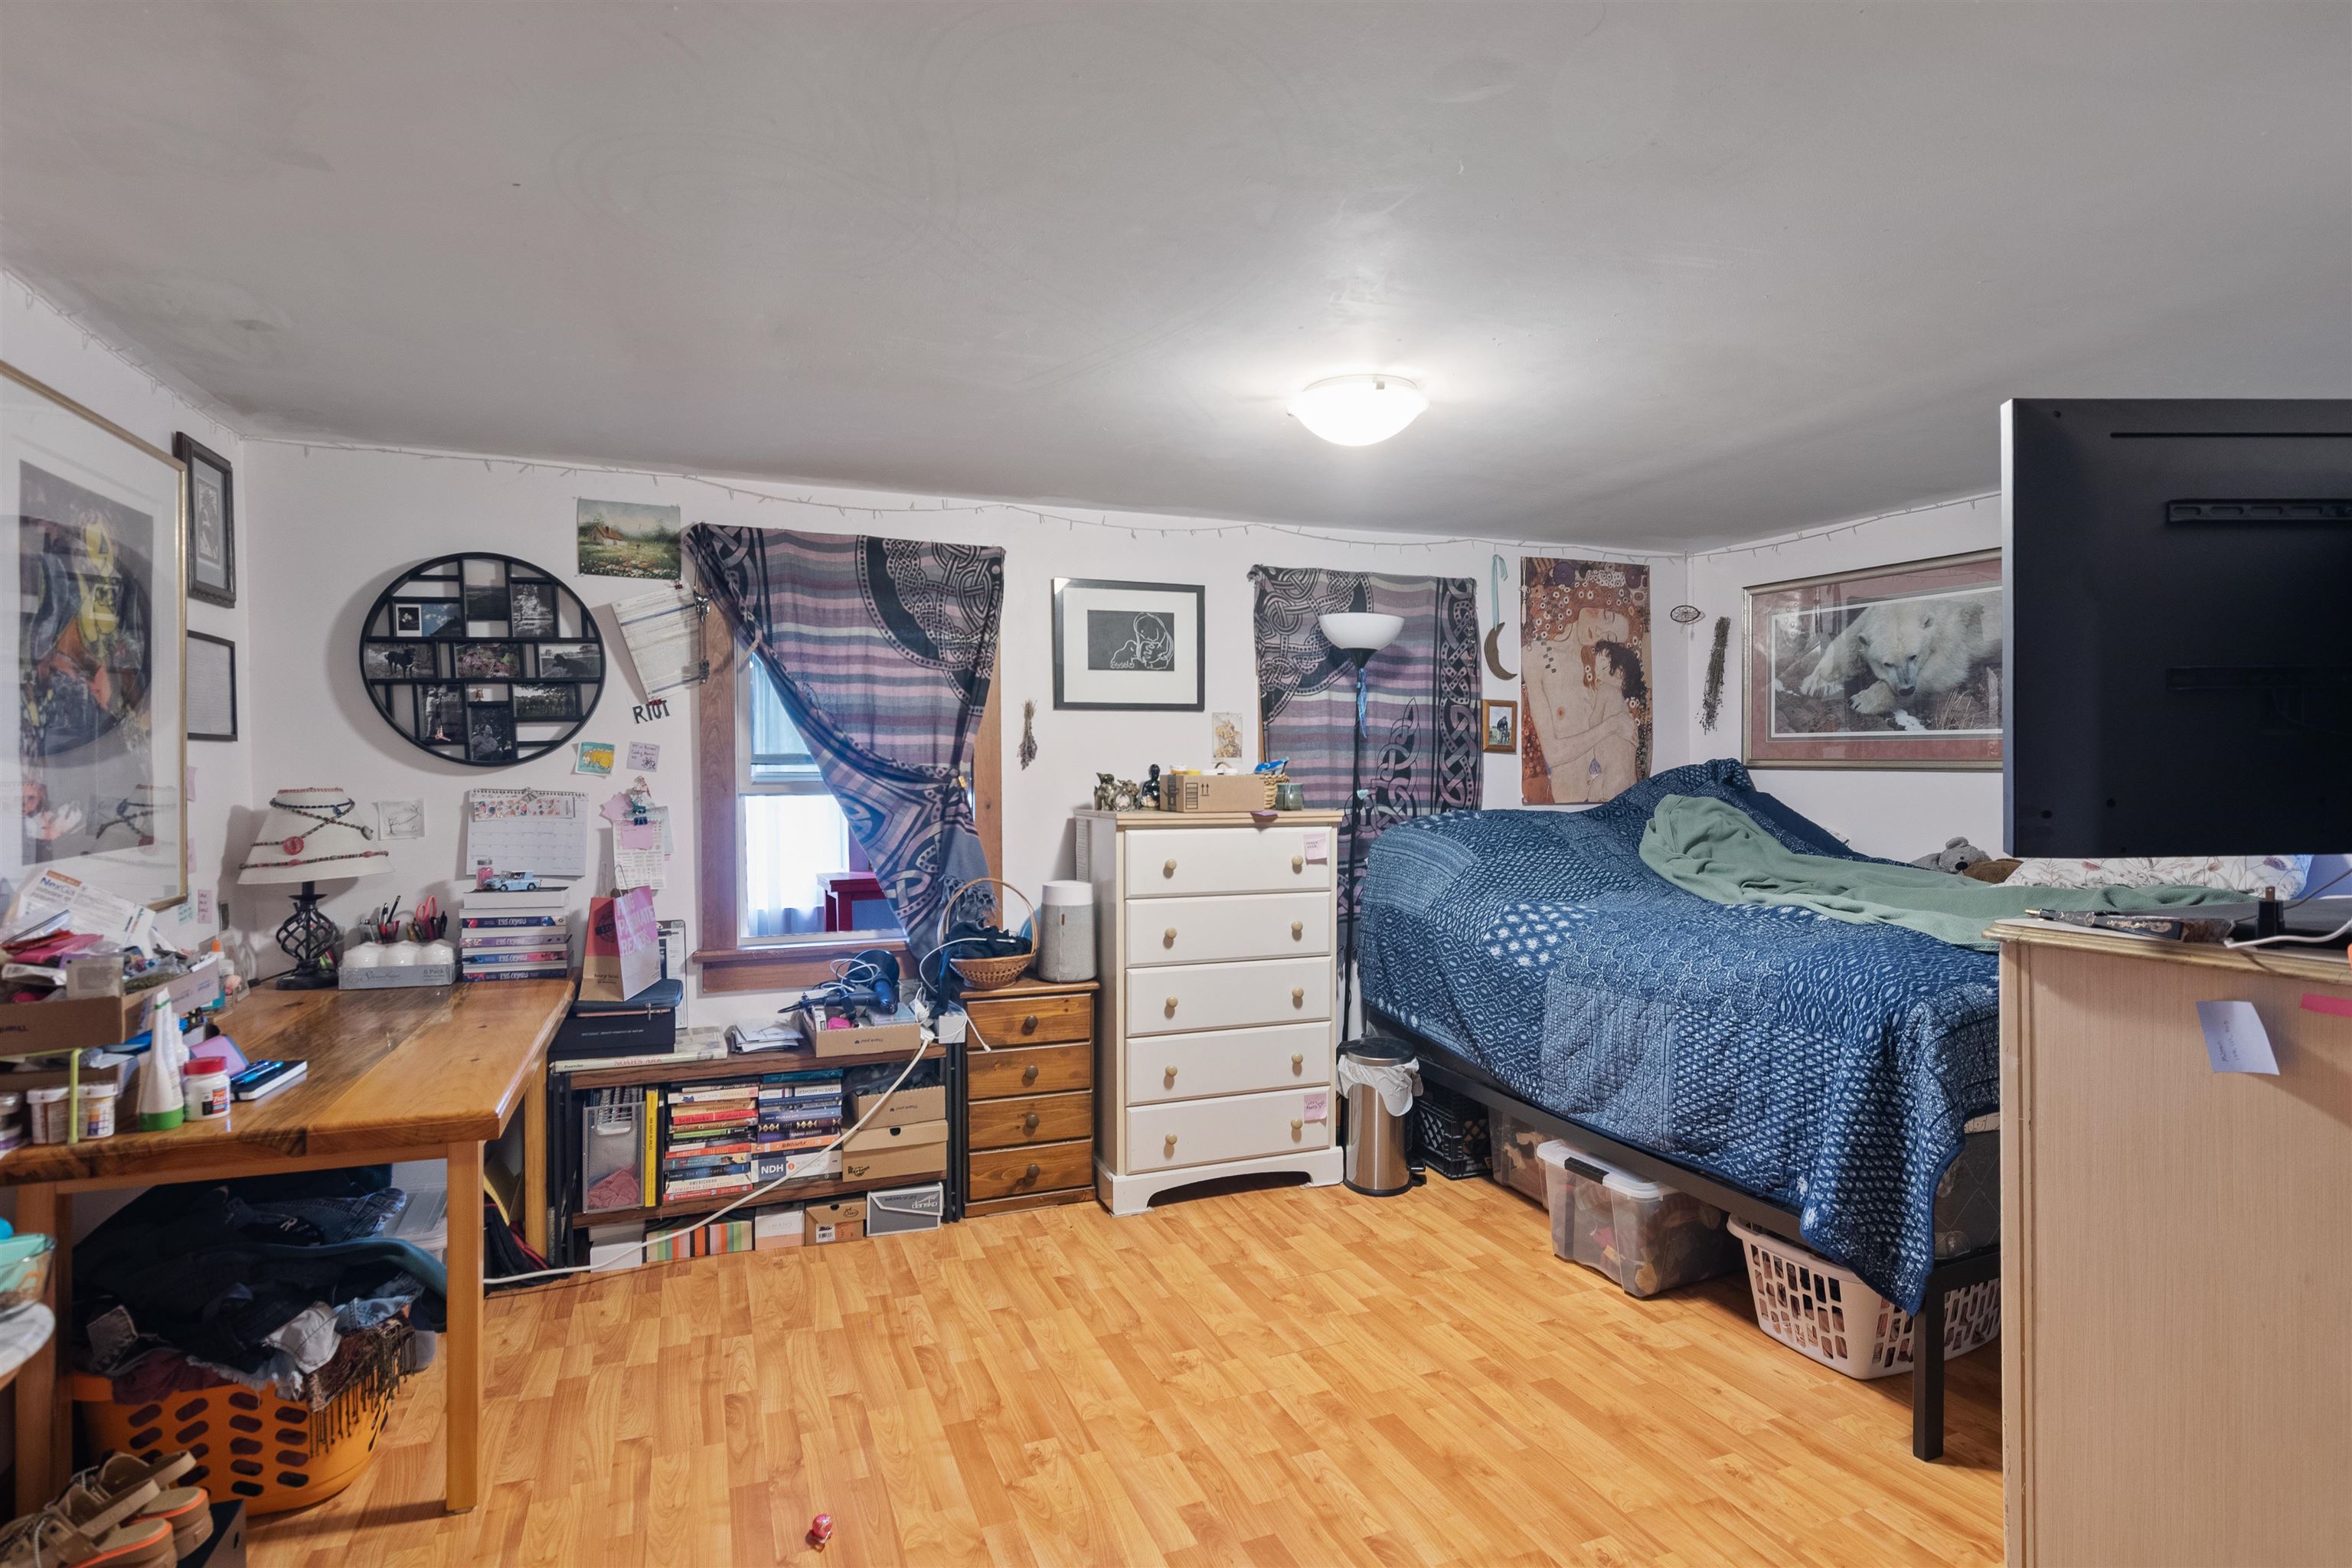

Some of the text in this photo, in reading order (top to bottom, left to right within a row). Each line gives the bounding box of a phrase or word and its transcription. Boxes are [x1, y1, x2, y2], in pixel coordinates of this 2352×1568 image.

[632, 700, 670, 724] RIOT
[761, 1164, 783, 1174] NDH
[911, 1200, 938, 1209] dansko
